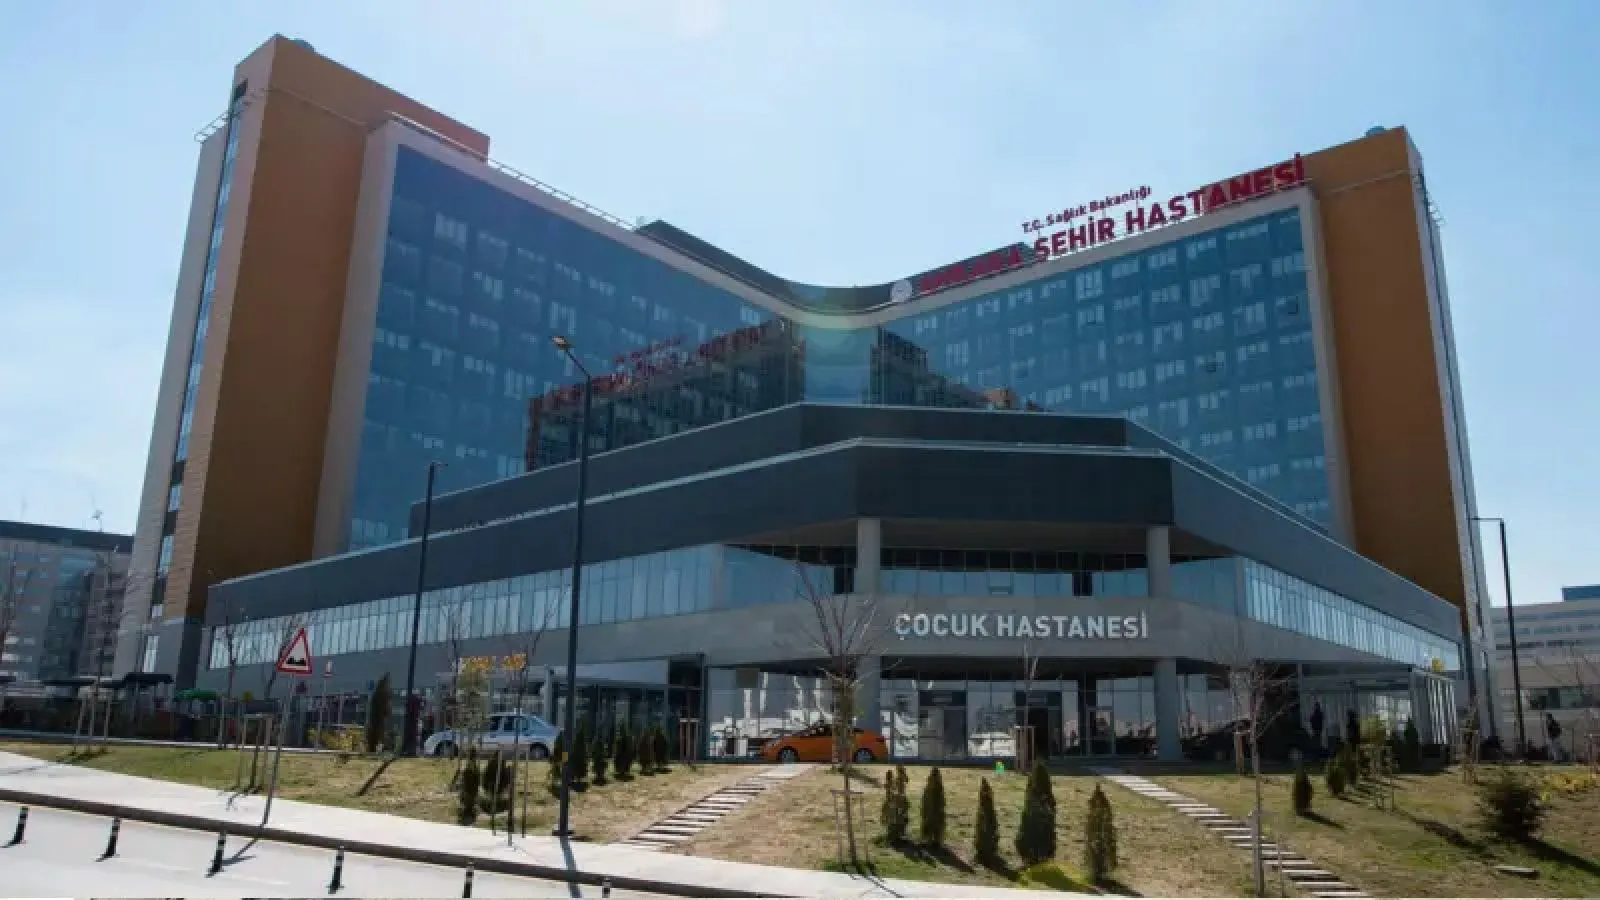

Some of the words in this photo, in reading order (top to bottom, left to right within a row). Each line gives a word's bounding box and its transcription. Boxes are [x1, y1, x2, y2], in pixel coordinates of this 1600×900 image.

[1126, 152, 1306, 234] HASTANESİ
[895, 613, 988, 640] ÇOCUK
[998, 609, 1149, 639] HASTANESİ
